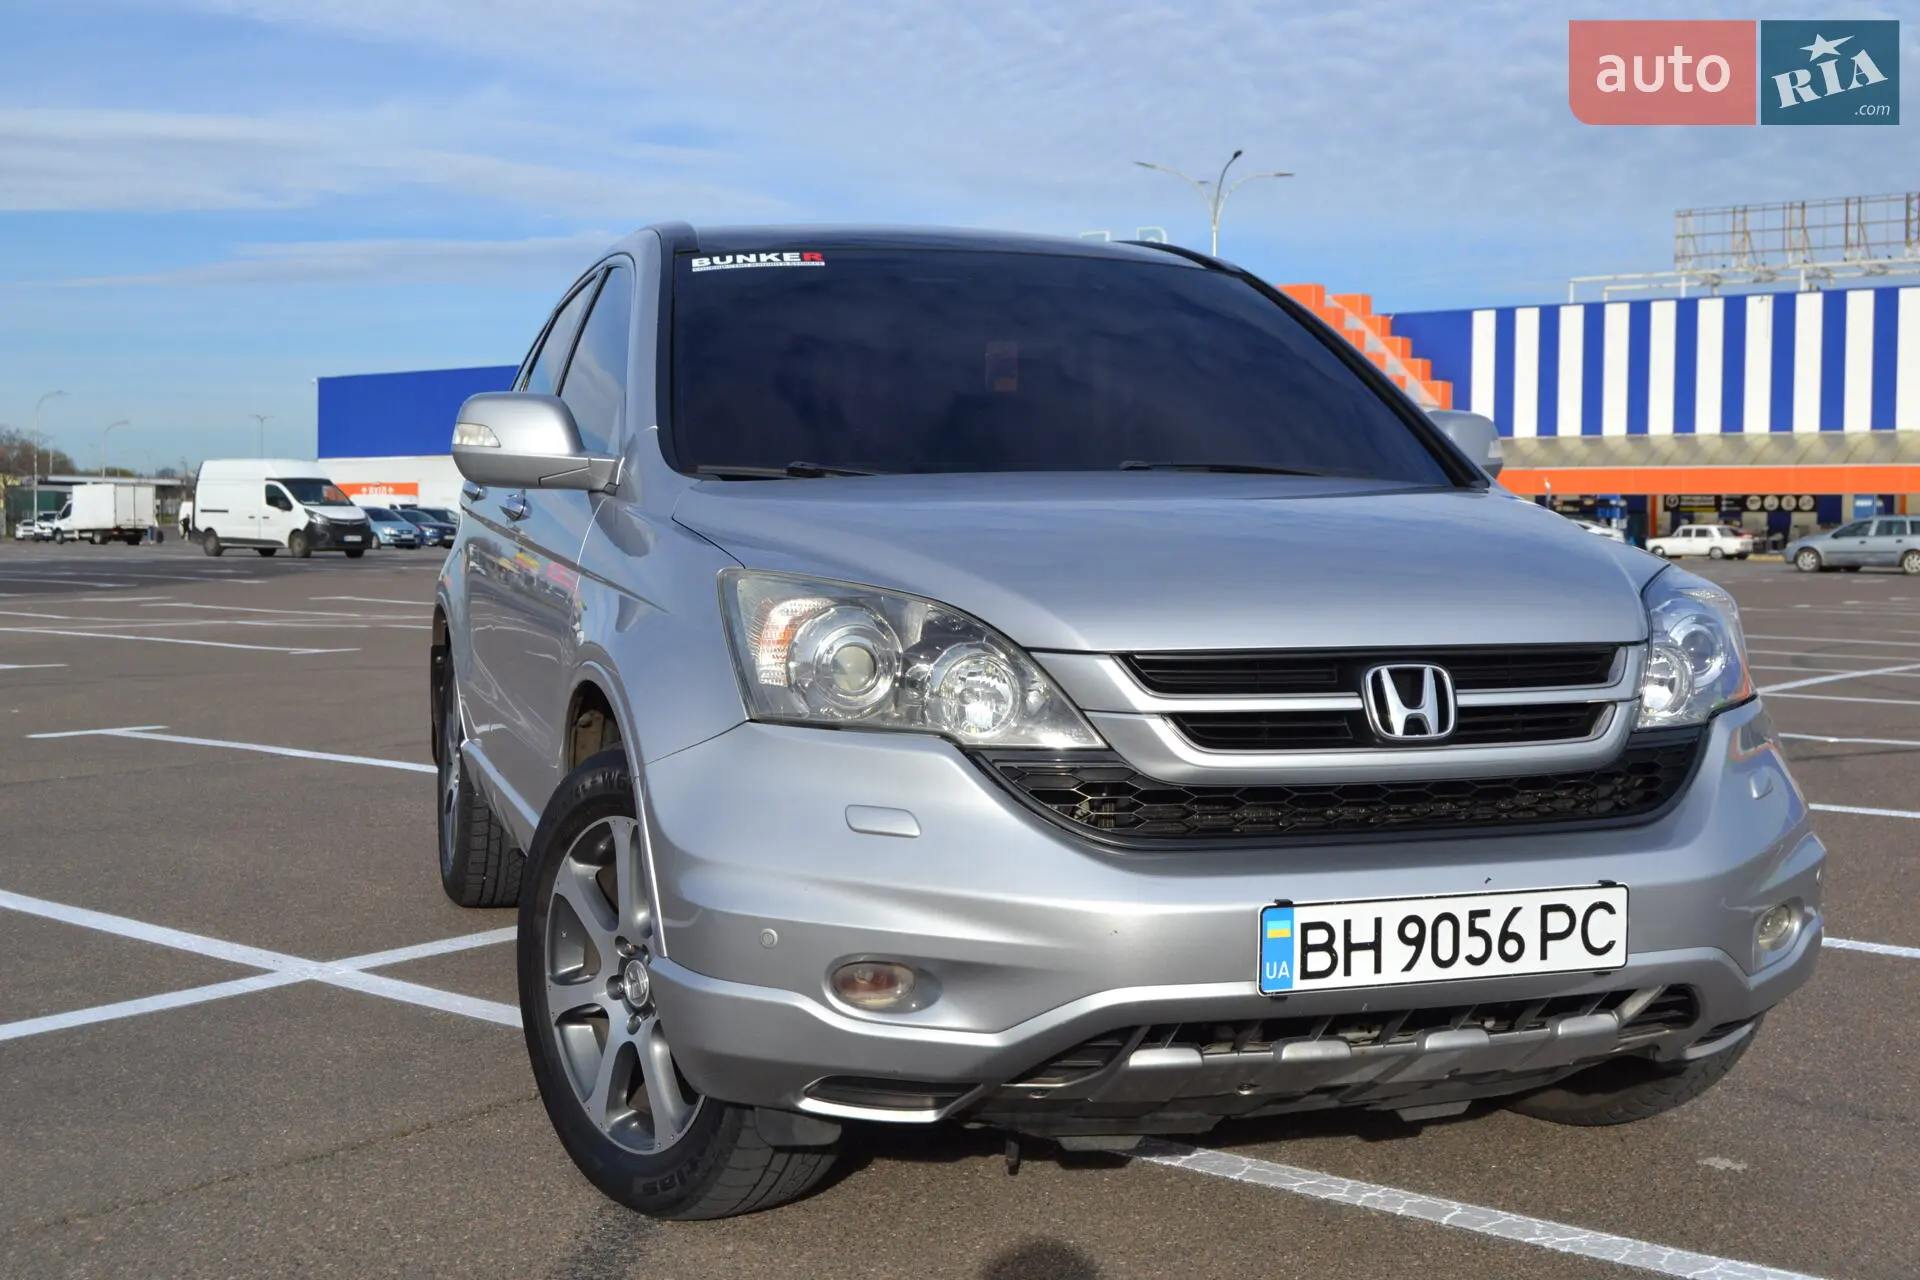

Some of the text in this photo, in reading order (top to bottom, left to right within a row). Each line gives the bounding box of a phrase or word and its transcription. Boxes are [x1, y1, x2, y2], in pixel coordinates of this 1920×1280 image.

[691, 252, 824, 268] BUNKER
[1300, 901, 1616, 980] BH 9056 PC
[1265, 961, 1290, 980] UA
